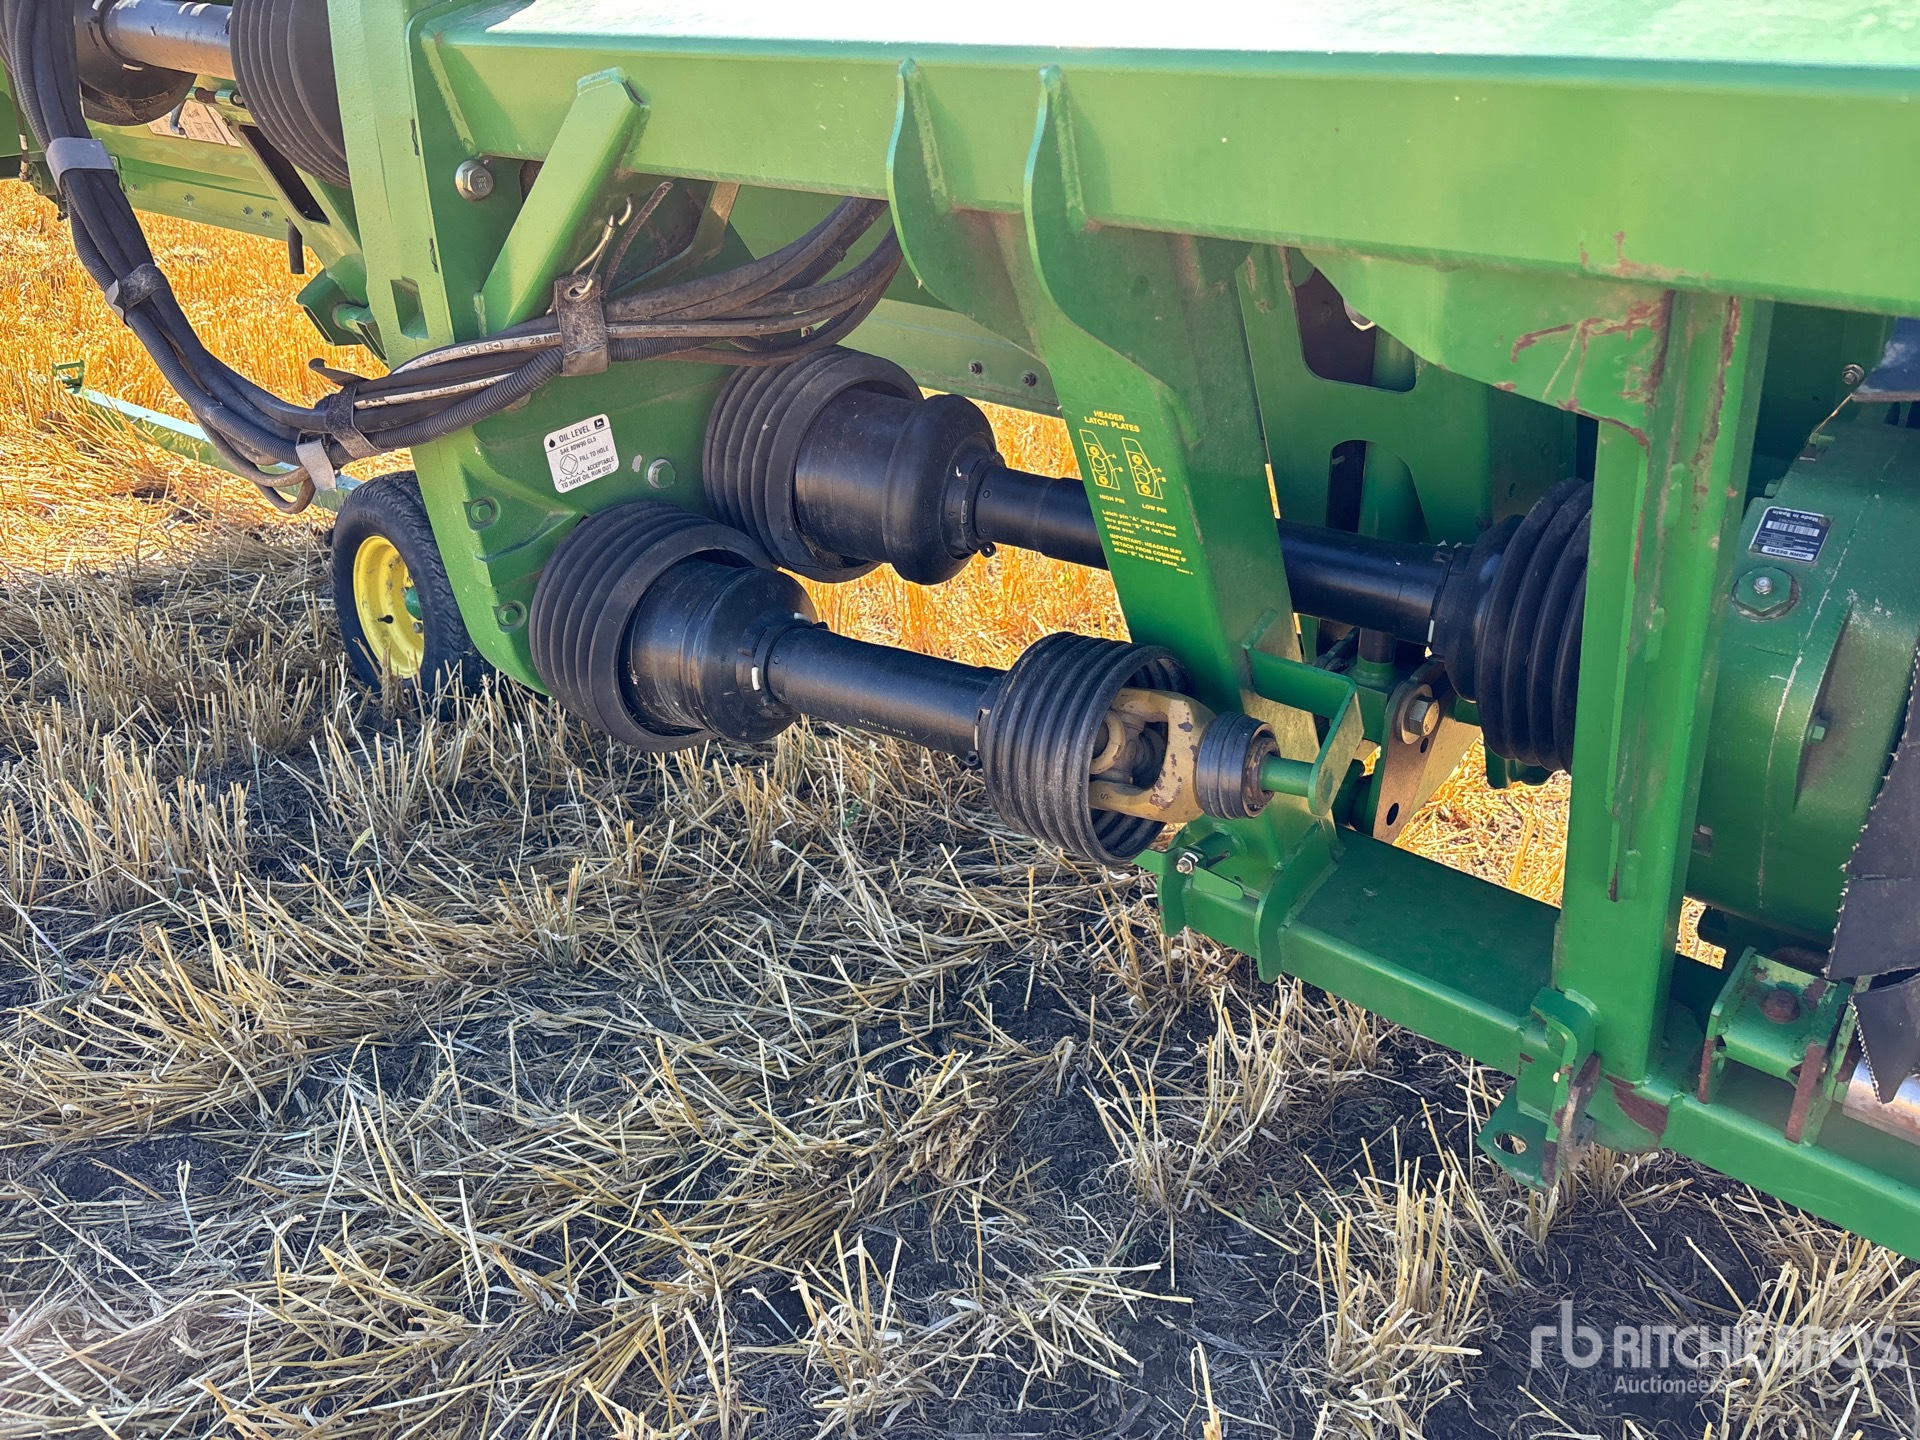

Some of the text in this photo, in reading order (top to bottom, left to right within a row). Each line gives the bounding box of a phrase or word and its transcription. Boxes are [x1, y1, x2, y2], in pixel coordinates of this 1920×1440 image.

[1093, 410, 1125, 422] HEADER
[1084, 416, 1140, 433] LATCH PLATES
[559, 425, 590, 442] OIL LEVEL
[571, 441, 586, 451] 80W90
[597, 446, 609, 454] HOLE
[587, 456, 614, 471] ACCEPTABLE
[569, 477, 581, 486] HAVE
[1156, 522, 1176, 531] extend
[1110, 534, 1144, 545] IMPORTANT:
[1144, 542, 1169, 551] HEADER
[1112, 540, 1134, 549] DETACH
[1135, 545, 1152, 554] FROM
[1153, 550, 1180, 561] COMBINE
